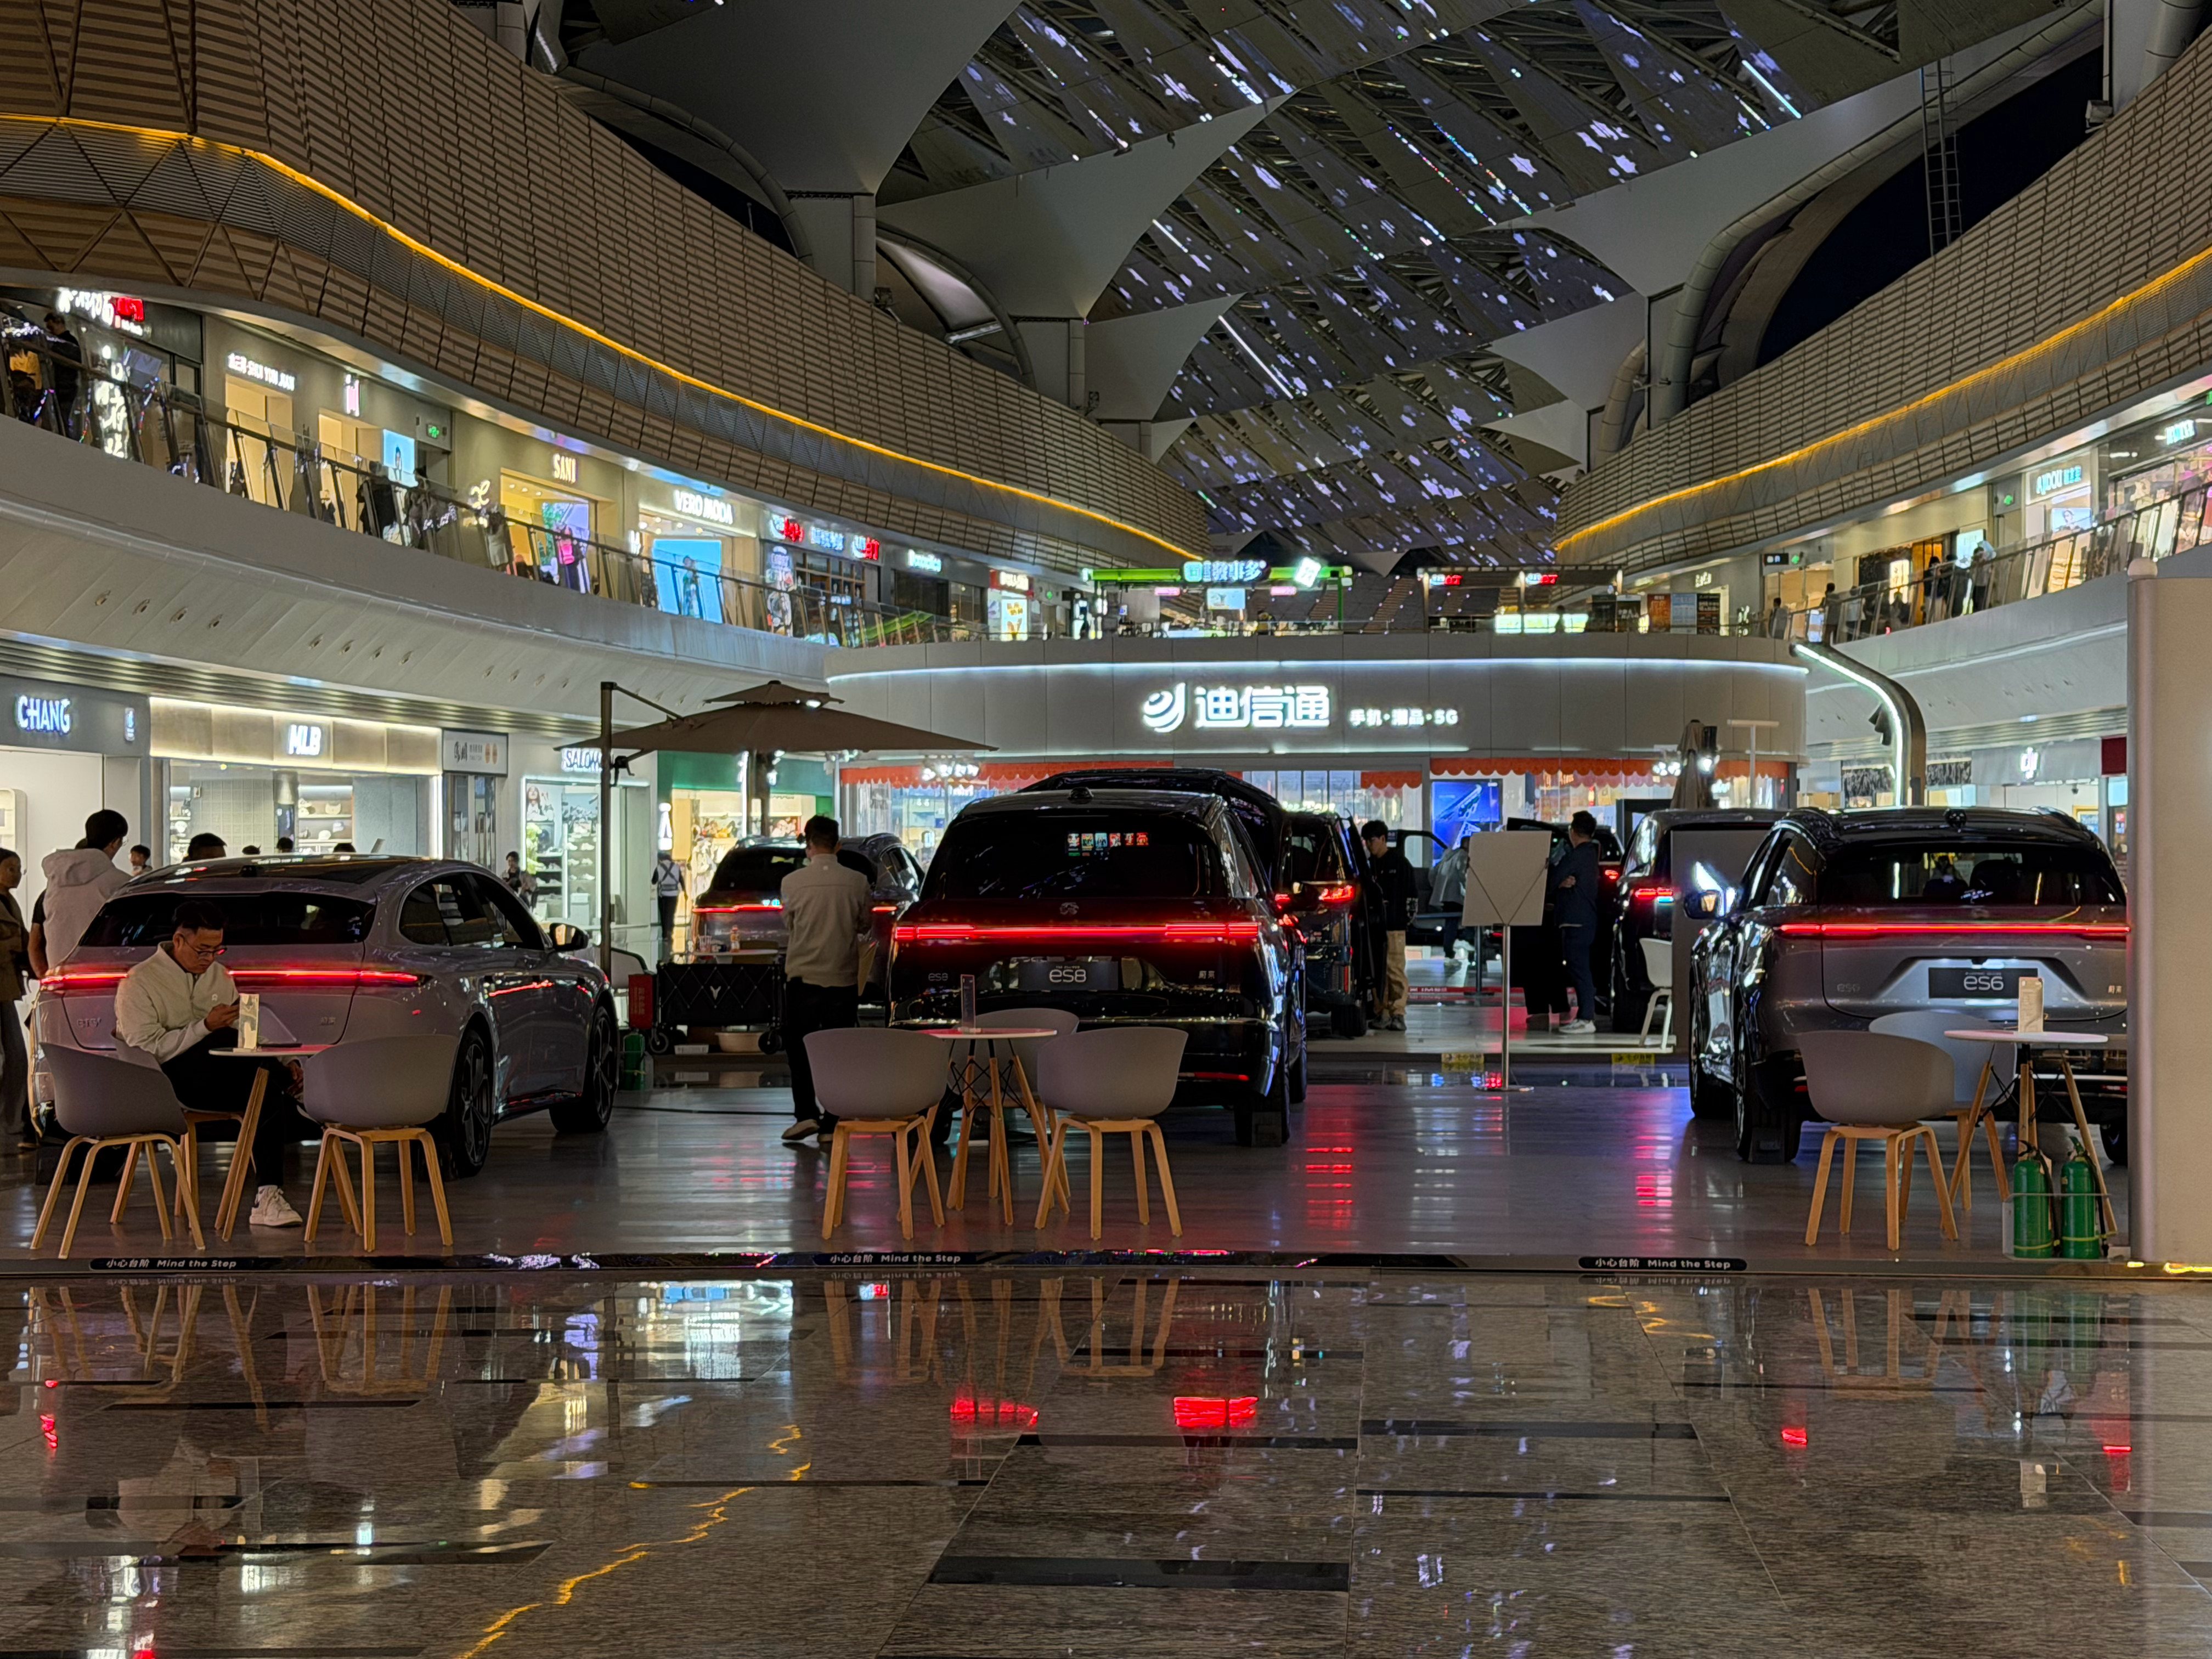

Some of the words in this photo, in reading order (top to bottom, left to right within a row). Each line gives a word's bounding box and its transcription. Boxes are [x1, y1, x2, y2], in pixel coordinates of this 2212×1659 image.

[674, 489, 703, 516] VERO
[703, 497, 733, 525] MODA
[17, 695, 71, 733] CHANG
[1195, 686, 1330, 729] 迪信通
[289, 724, 321, 755] MLB
[106, 1258, 150, 1268] 小心台阶
[156, 1259, 185, 1268] Mind
[189, 1259, 208, 1267] the
[211, 1260, 236, 1269] Step
[830, 1254, 873, 1263] 小心台阶
[881, 1254, 909, 1263] Mind
[913, 1254, 932, 1262] the
[935, 1254, 961, 1264] Step
[1595, 1258, 1640, 1268] 小心台阶
[1647, 1259, 1677, 1268] Mind
[1680, 1260, 1700, 1268] the
[1704, 1260, 1730, 1270] Step
